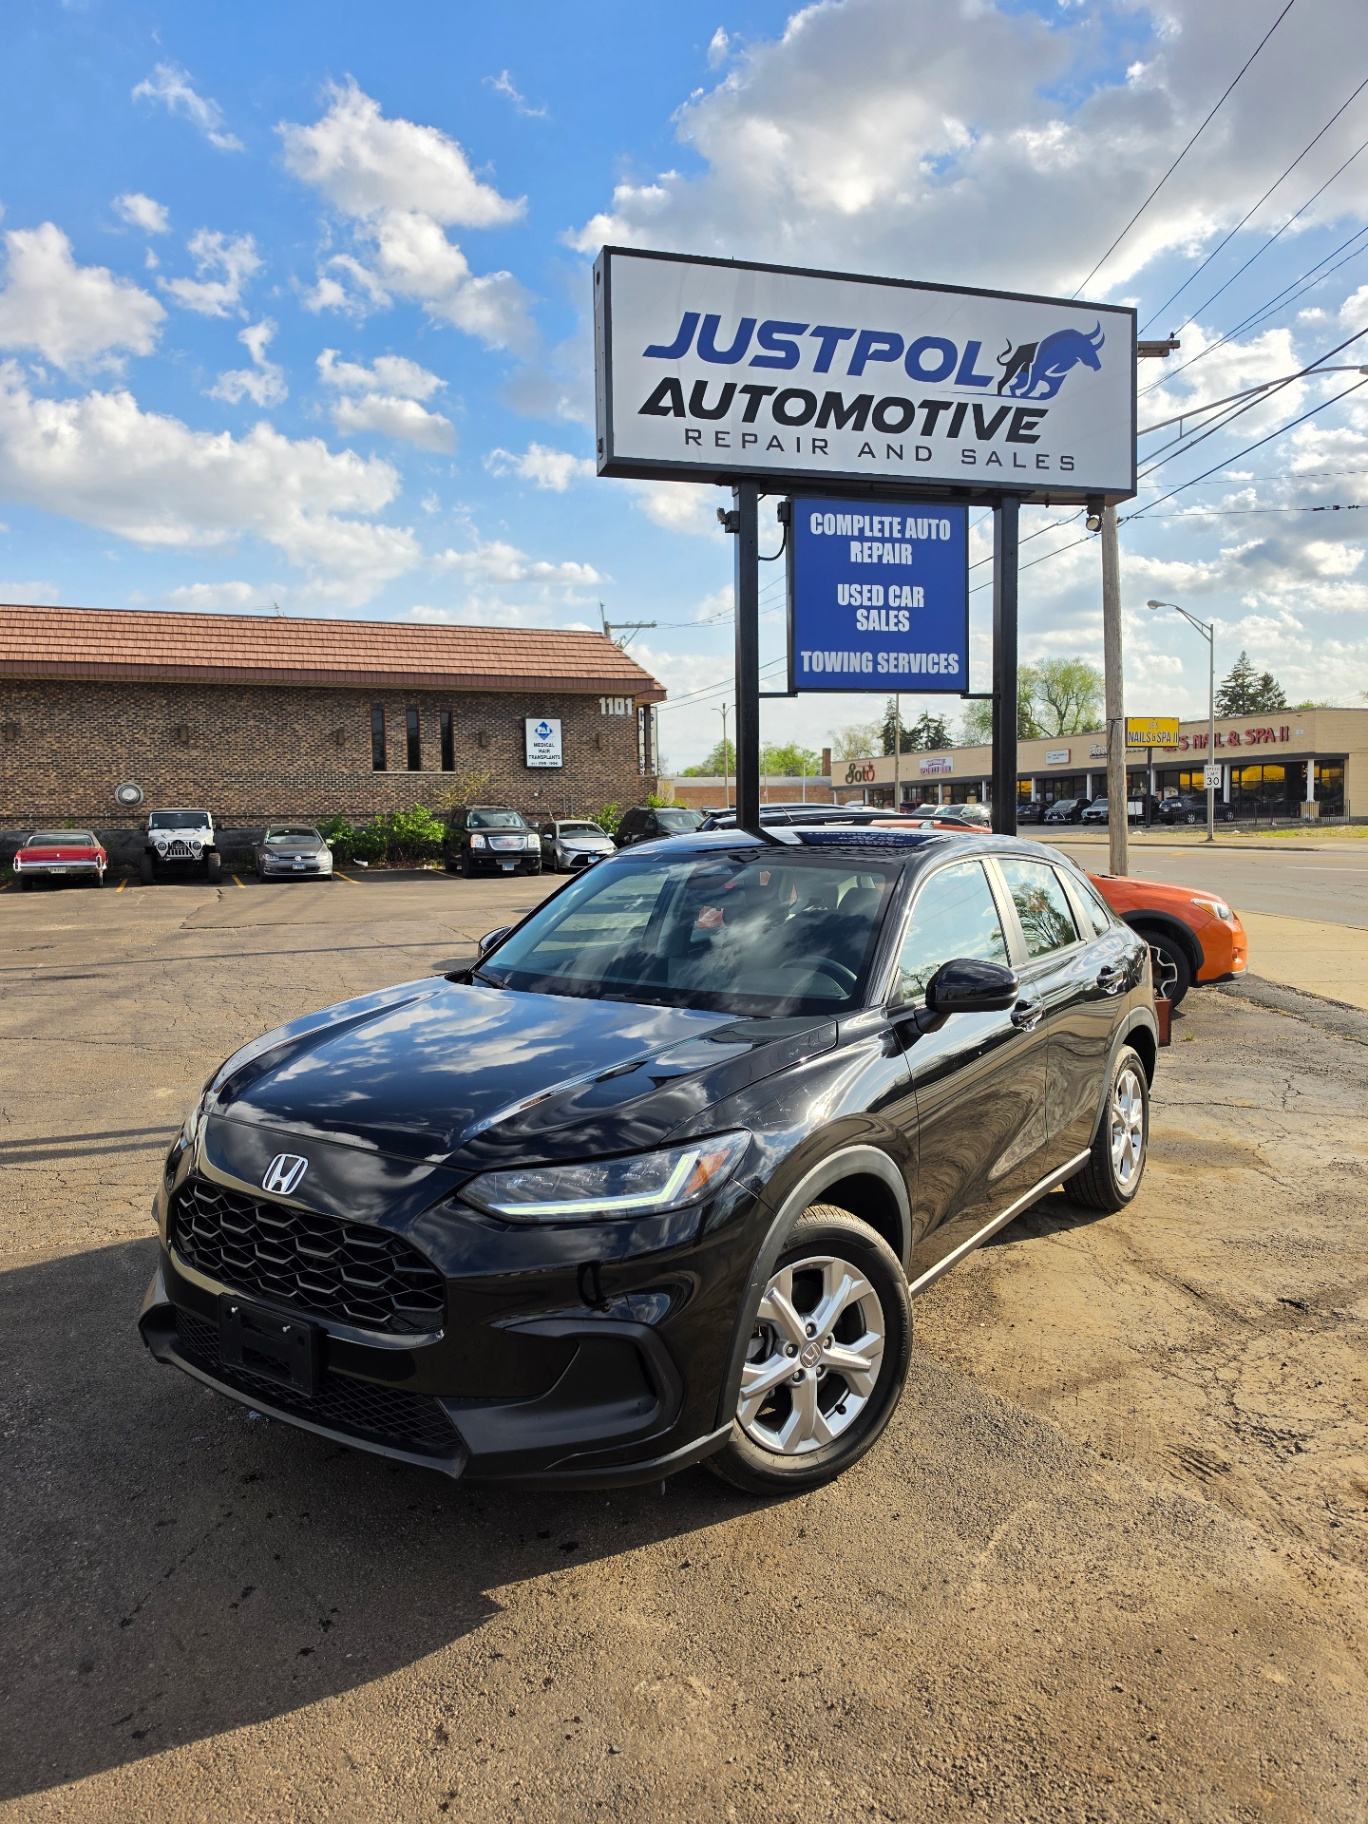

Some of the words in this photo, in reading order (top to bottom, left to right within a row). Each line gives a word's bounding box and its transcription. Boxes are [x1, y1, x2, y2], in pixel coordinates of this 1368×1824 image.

[641, 311, 995, 388] JUSTPOL
[637, 376, 1049, 444] AUTOMOTIVE
[684, 427, 829, 455] REPAIR
[857, 441, 933, 462] AND
[960, 448, 1075, 471] SALES
[810, 512, 902, 538] COMPLETE
[905, 517, 951, 541] AUTO
[850, 541, 913, 565] REPAIR
[837, 583, 884, 607] USED
[888, 585, 925, 608] CAR
[856, 608, 910, 632] SALES
[800, 651, 873, 673] TOWING
[877, 652, 960, 674] SERVICES
[599, 697, 633, 715] 1101
[1128, 731, 1151, 743] NAILS
[1156, 731, 1171, 743] SPA
[1227, 730, 1241, 747] &
[1244, 727, 1276, 746] SPA
[1279, 725, 1290, 742] II
[1206, 776, 1220, 786] 30
